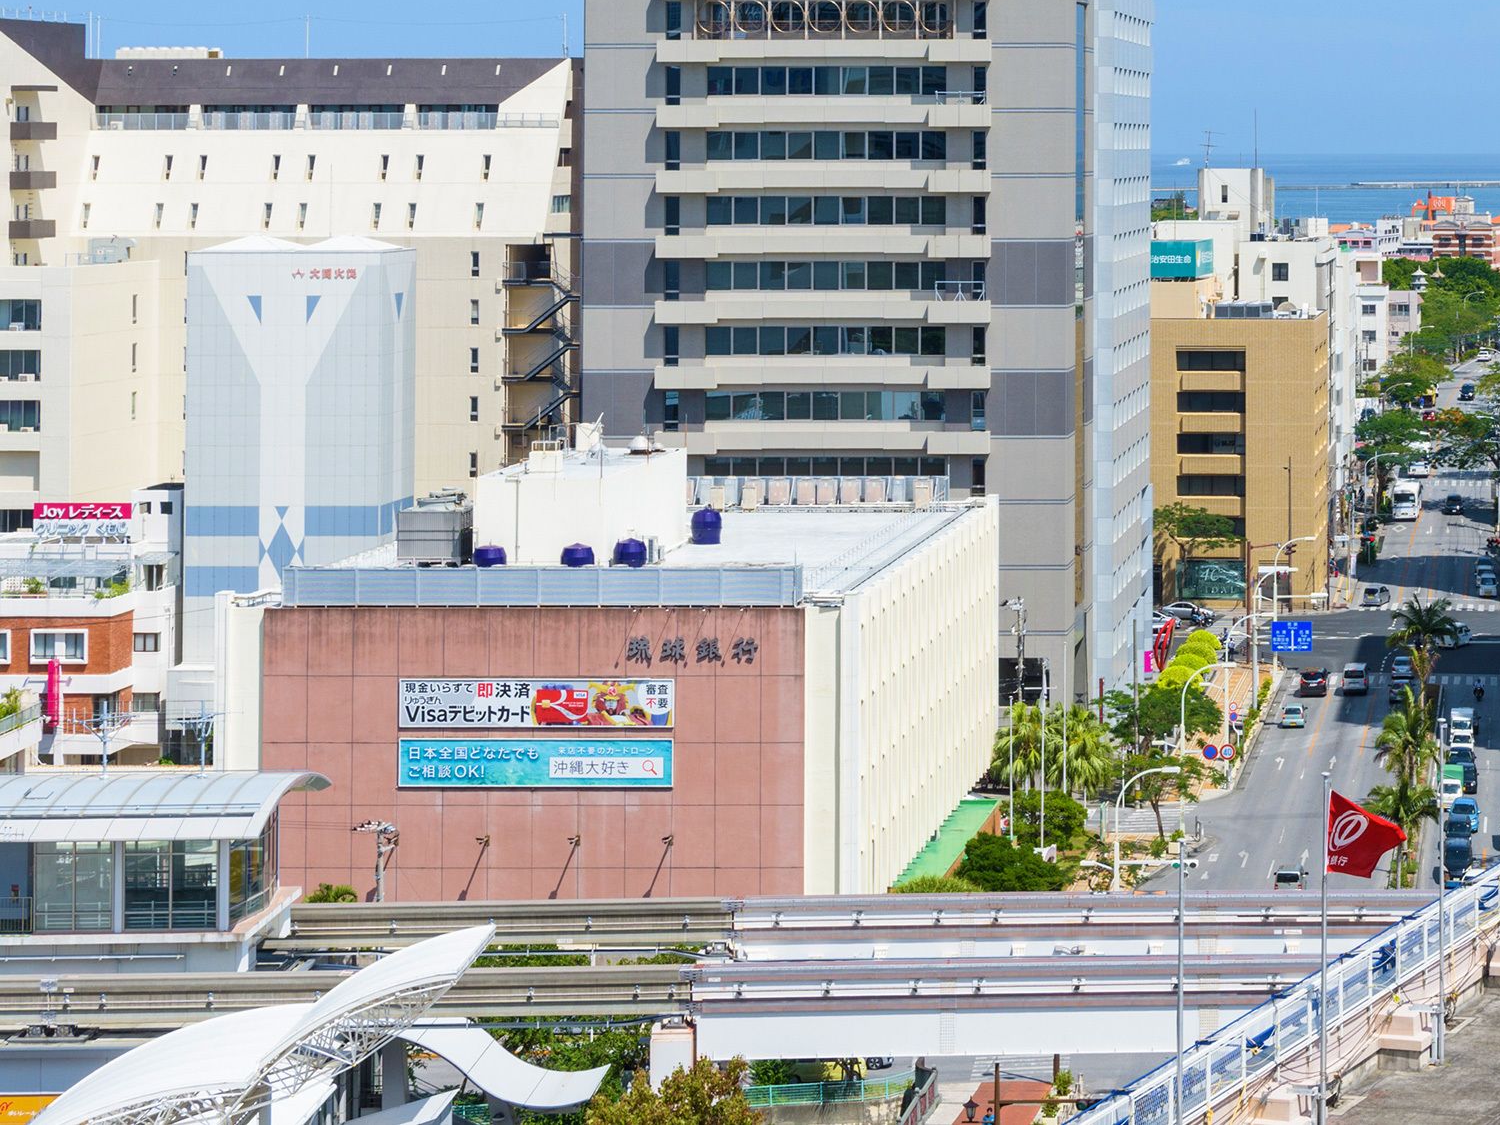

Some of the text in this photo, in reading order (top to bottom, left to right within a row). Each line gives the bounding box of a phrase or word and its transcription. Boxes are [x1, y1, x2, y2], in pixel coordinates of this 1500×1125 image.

[40, 504, 124, 518] Joy レディース
[626, 635, 758, 668] 琉球銀行
[477, 683, 530, 698] 即決済
[405, 705, 530, 723] Visaデビットカード
[409, 746, 539, 760] 日本全国どなたでも
[553, 760, 629, 775] 沖縄大好き
